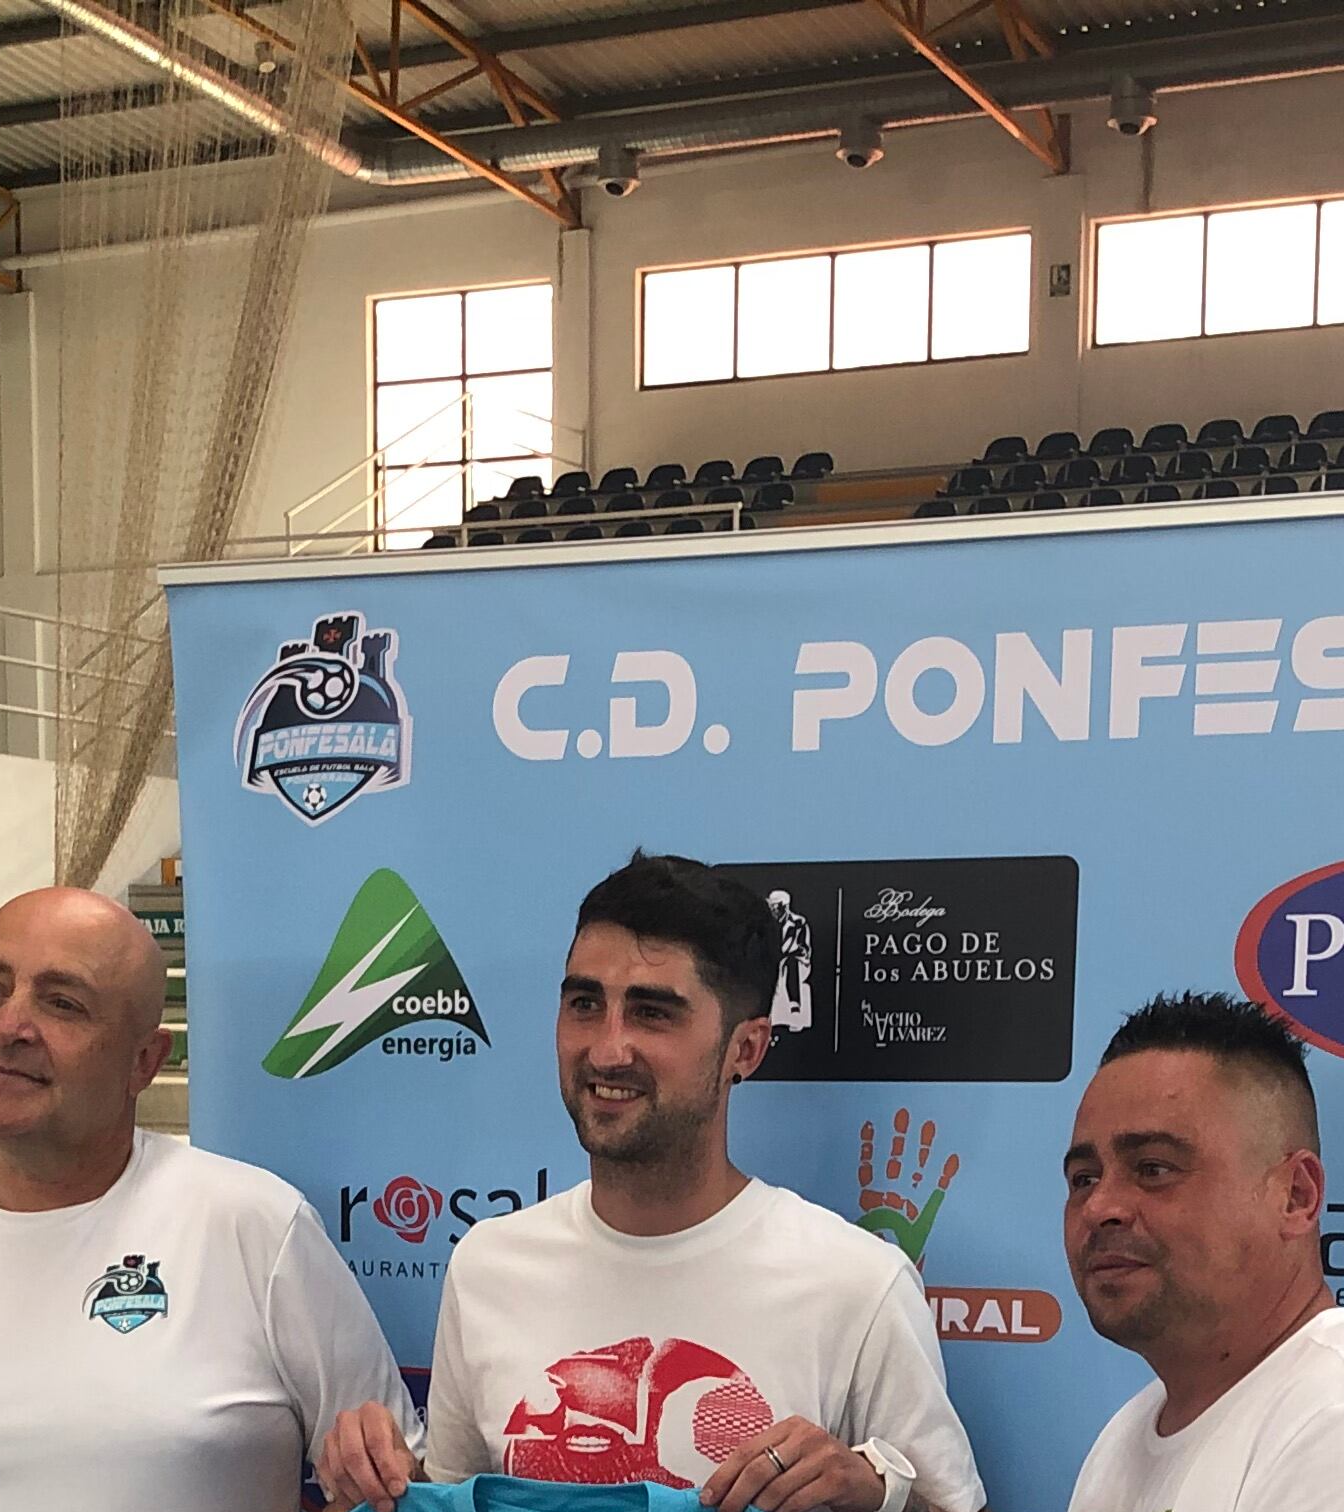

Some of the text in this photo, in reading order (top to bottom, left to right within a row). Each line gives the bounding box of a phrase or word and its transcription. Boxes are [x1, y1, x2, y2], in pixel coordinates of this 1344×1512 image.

[492, 650, 730, 761] C.D.
[258, 724, 397, 764] PONFESALA
[864, 887, 946, 928] Bodega
[865, 931, 1000, 955] PAGO DE
[864, 958, 1055, 982] los ABUELOS
[392, 989, 470, 1015] coebb
[382, 1030, 476, 1062] energía
